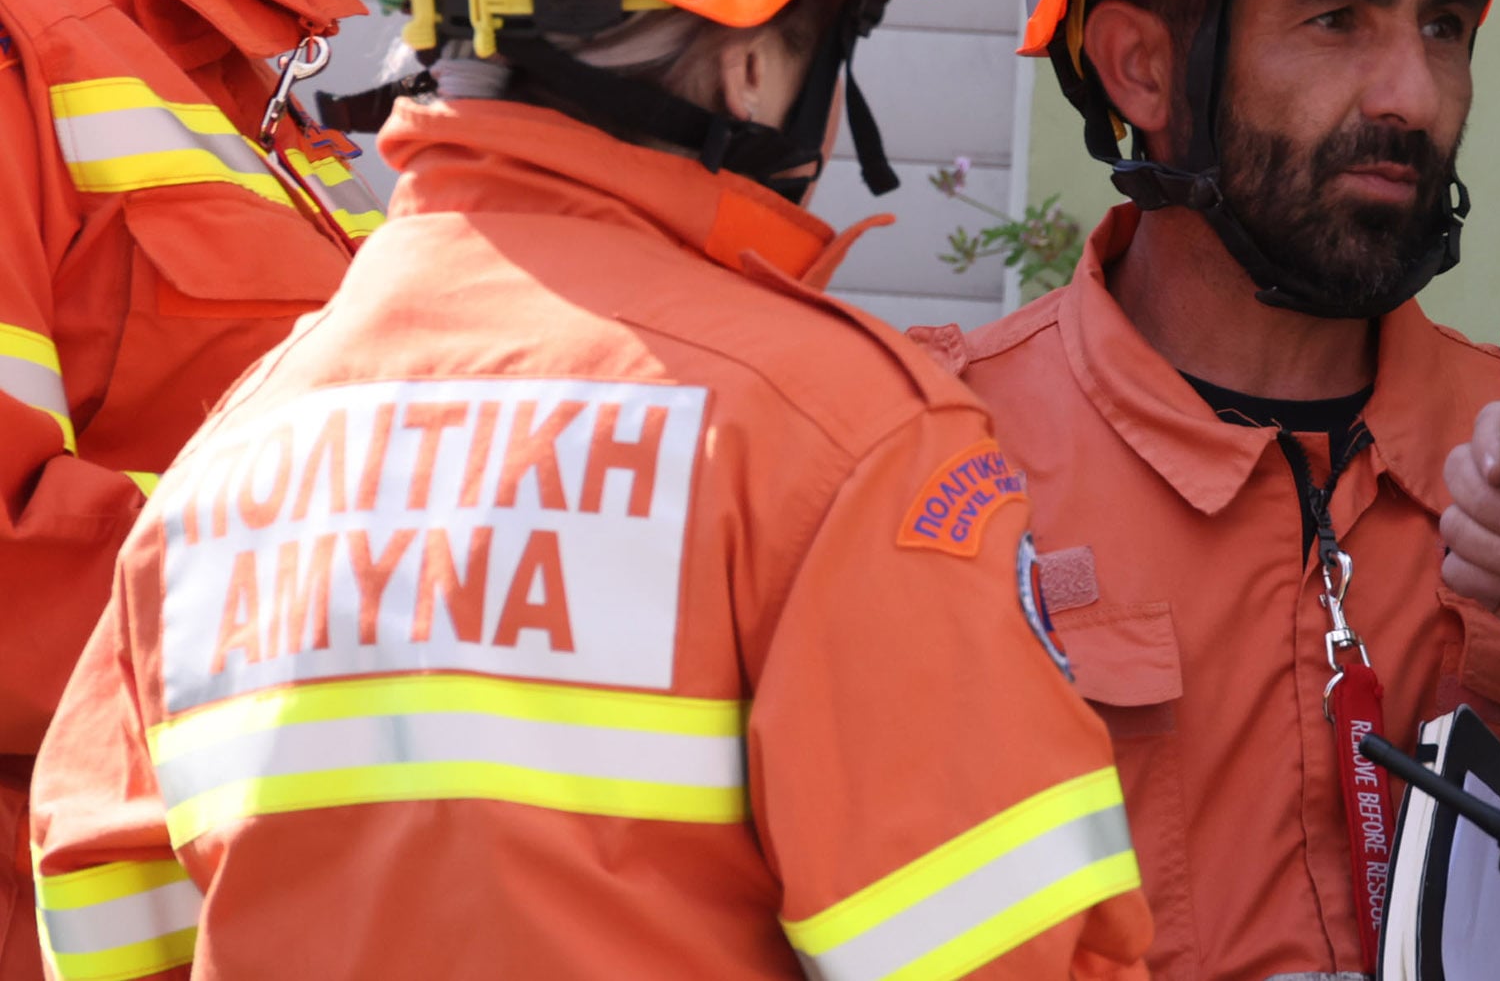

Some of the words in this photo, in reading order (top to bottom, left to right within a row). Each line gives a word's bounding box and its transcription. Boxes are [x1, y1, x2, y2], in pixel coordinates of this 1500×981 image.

[950, 489, 996, 543] CIVIL
[209, 525, 576, 677] ΑΜΥΝΑ
[1357, 791, 1388, 856] BEFORE
